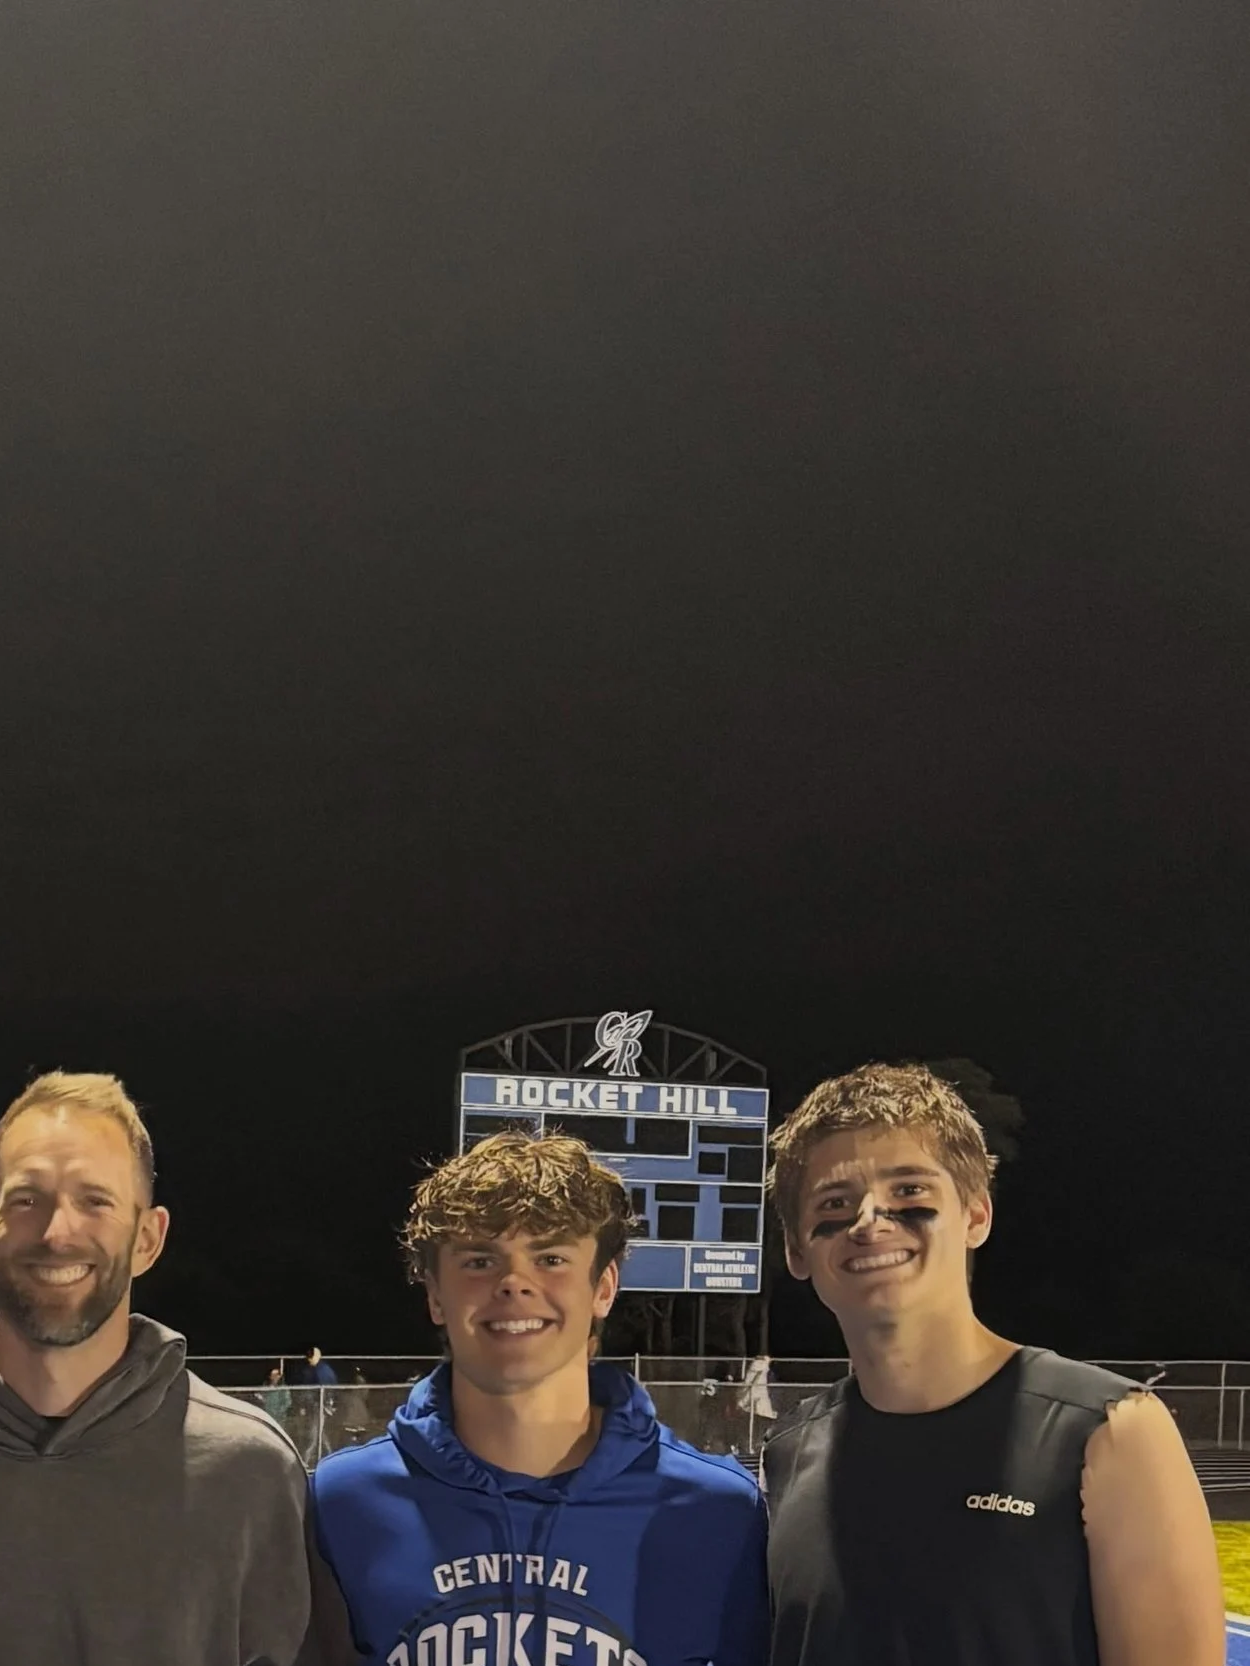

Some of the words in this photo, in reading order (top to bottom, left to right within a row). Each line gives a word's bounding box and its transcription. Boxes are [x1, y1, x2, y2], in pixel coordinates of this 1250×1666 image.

[495, 1078, 643, 1111] ROCKET
[659, 1087, 737, 1115] HILL
[966, 1492, 1036, 1516] adidas
[433, 1553, 589, 1597] CENTRAL
